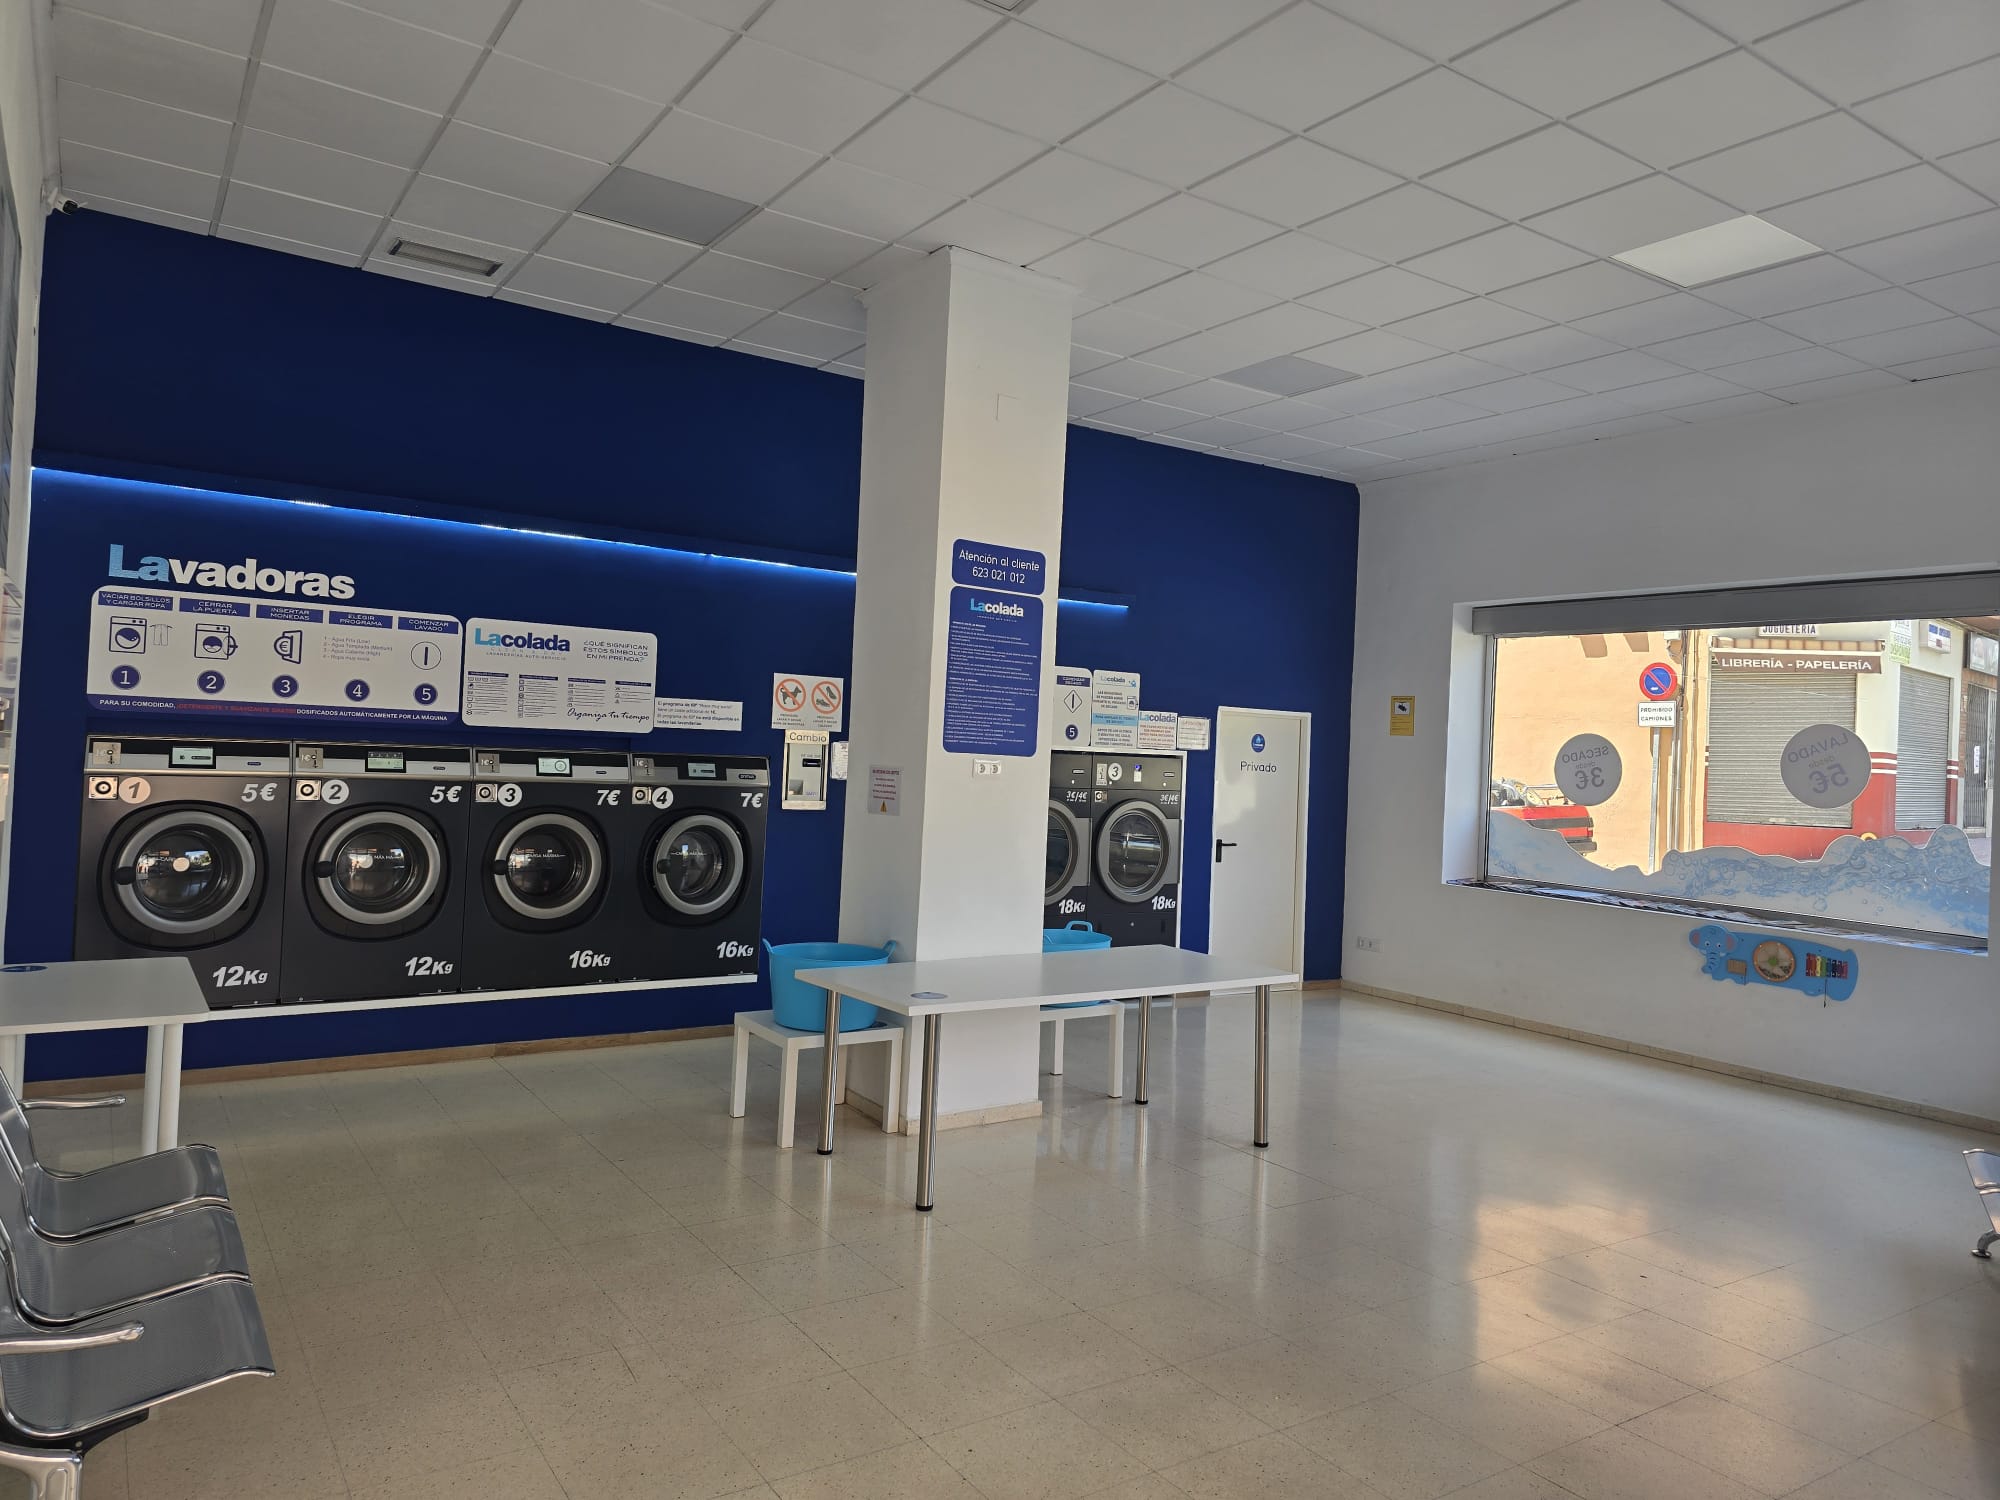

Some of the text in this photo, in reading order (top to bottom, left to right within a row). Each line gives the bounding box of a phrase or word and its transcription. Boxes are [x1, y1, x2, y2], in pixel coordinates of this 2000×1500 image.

[959, 549, 1040, 572] Atención al cliente
[108, 544, 355, 599] Lavadoras
[972, 566, 1025, 584] 623 021 012
[130, 595, 170, 604] BOLSILLOS
[204, 606, 238, 614] PUERTA
[270, 607, 310, 615] INSERTAR
[970, 598, 1024, 617] Lacolada
[270, 613, 310, 621] MONEDAS
[340, 618, 382, 626] PROGRAMA
[408, 619, 449, 628] COMENZAR
[474, 628, 570, 652] Lacolada
[606, 642, 648, 650] SIGNIFICAN
[608, 655, 645, 663] PRENDA?
[610, 648, 648, 656] SÍMBOLOS
[1722, 658, 1784, 668] LIBRERÍA
[1796, 660, 1872, 670] PAPELERÍA
[120, 670, 130, 684] 1
[206, 676, 216, 690] 2
[280, 680, 291, 694] 3
[352, 684, 362, 698] 4
[422, 688, 432, 700] 5
[132, 702, 176, 710] COMODIDAD,
[567, 708, 606, 722] Organiza
[620, 712, 650, 722] tiempo
[1140, 712, 1176, 723] Lacolada
[789, 732, 826, 743] Cambio
[1069, 728, 1075, 738] 5
[1112, 766, 1118, 778] 3
[1240, 761, 1276, 773] Privado
[128, 782, 141, 798] 1
[241, 782, 278, 803] 5€
[328, 784, 342, 800] 2
[430, 785, 462, 803] 5€
[504, 788, 516, 802] 3
[656, 790, 668, 804] 4
[596, 790, 621, 806] 7€
[740, 792, 764, 808] 7€
[1059, 898, 1086, 914] 18Kg
[1152, 896, 1176, 910] 18Kg
[716, 941, 754, 959] 16Kg
[406, 956, 453, 977] 12Kg
[569, 950, 611, 969] 16Kg
[212, 966, 268, 988] 12Kg
